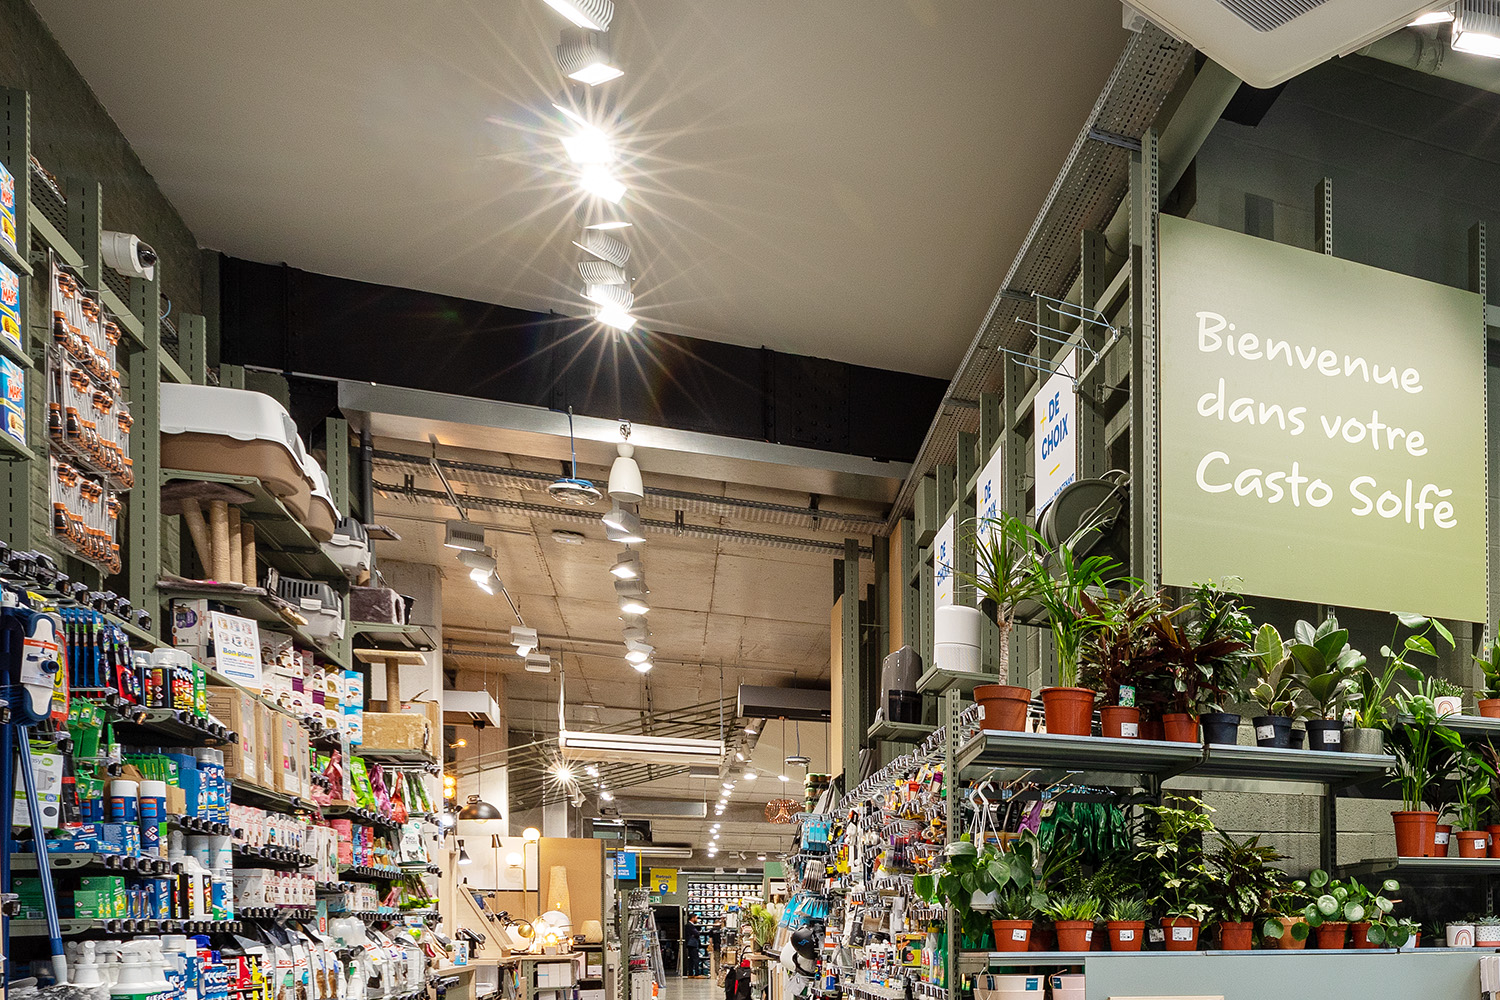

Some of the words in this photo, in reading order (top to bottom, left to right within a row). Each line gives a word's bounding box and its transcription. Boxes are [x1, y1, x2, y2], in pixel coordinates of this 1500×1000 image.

[1195, 311, 1423, 394] Bienvenue
[1041, 412, 1069, 460] CHOIX
[1048, 391, 1060, 423] DE
[1196, 377, 1307, 436] dans
[1320, 410, 1428, 457] votre
[985, 479, 991, 504] DE
[1195, 450, 1334, 507] Casto
[1348, 476, 1457, 529] Solfé
